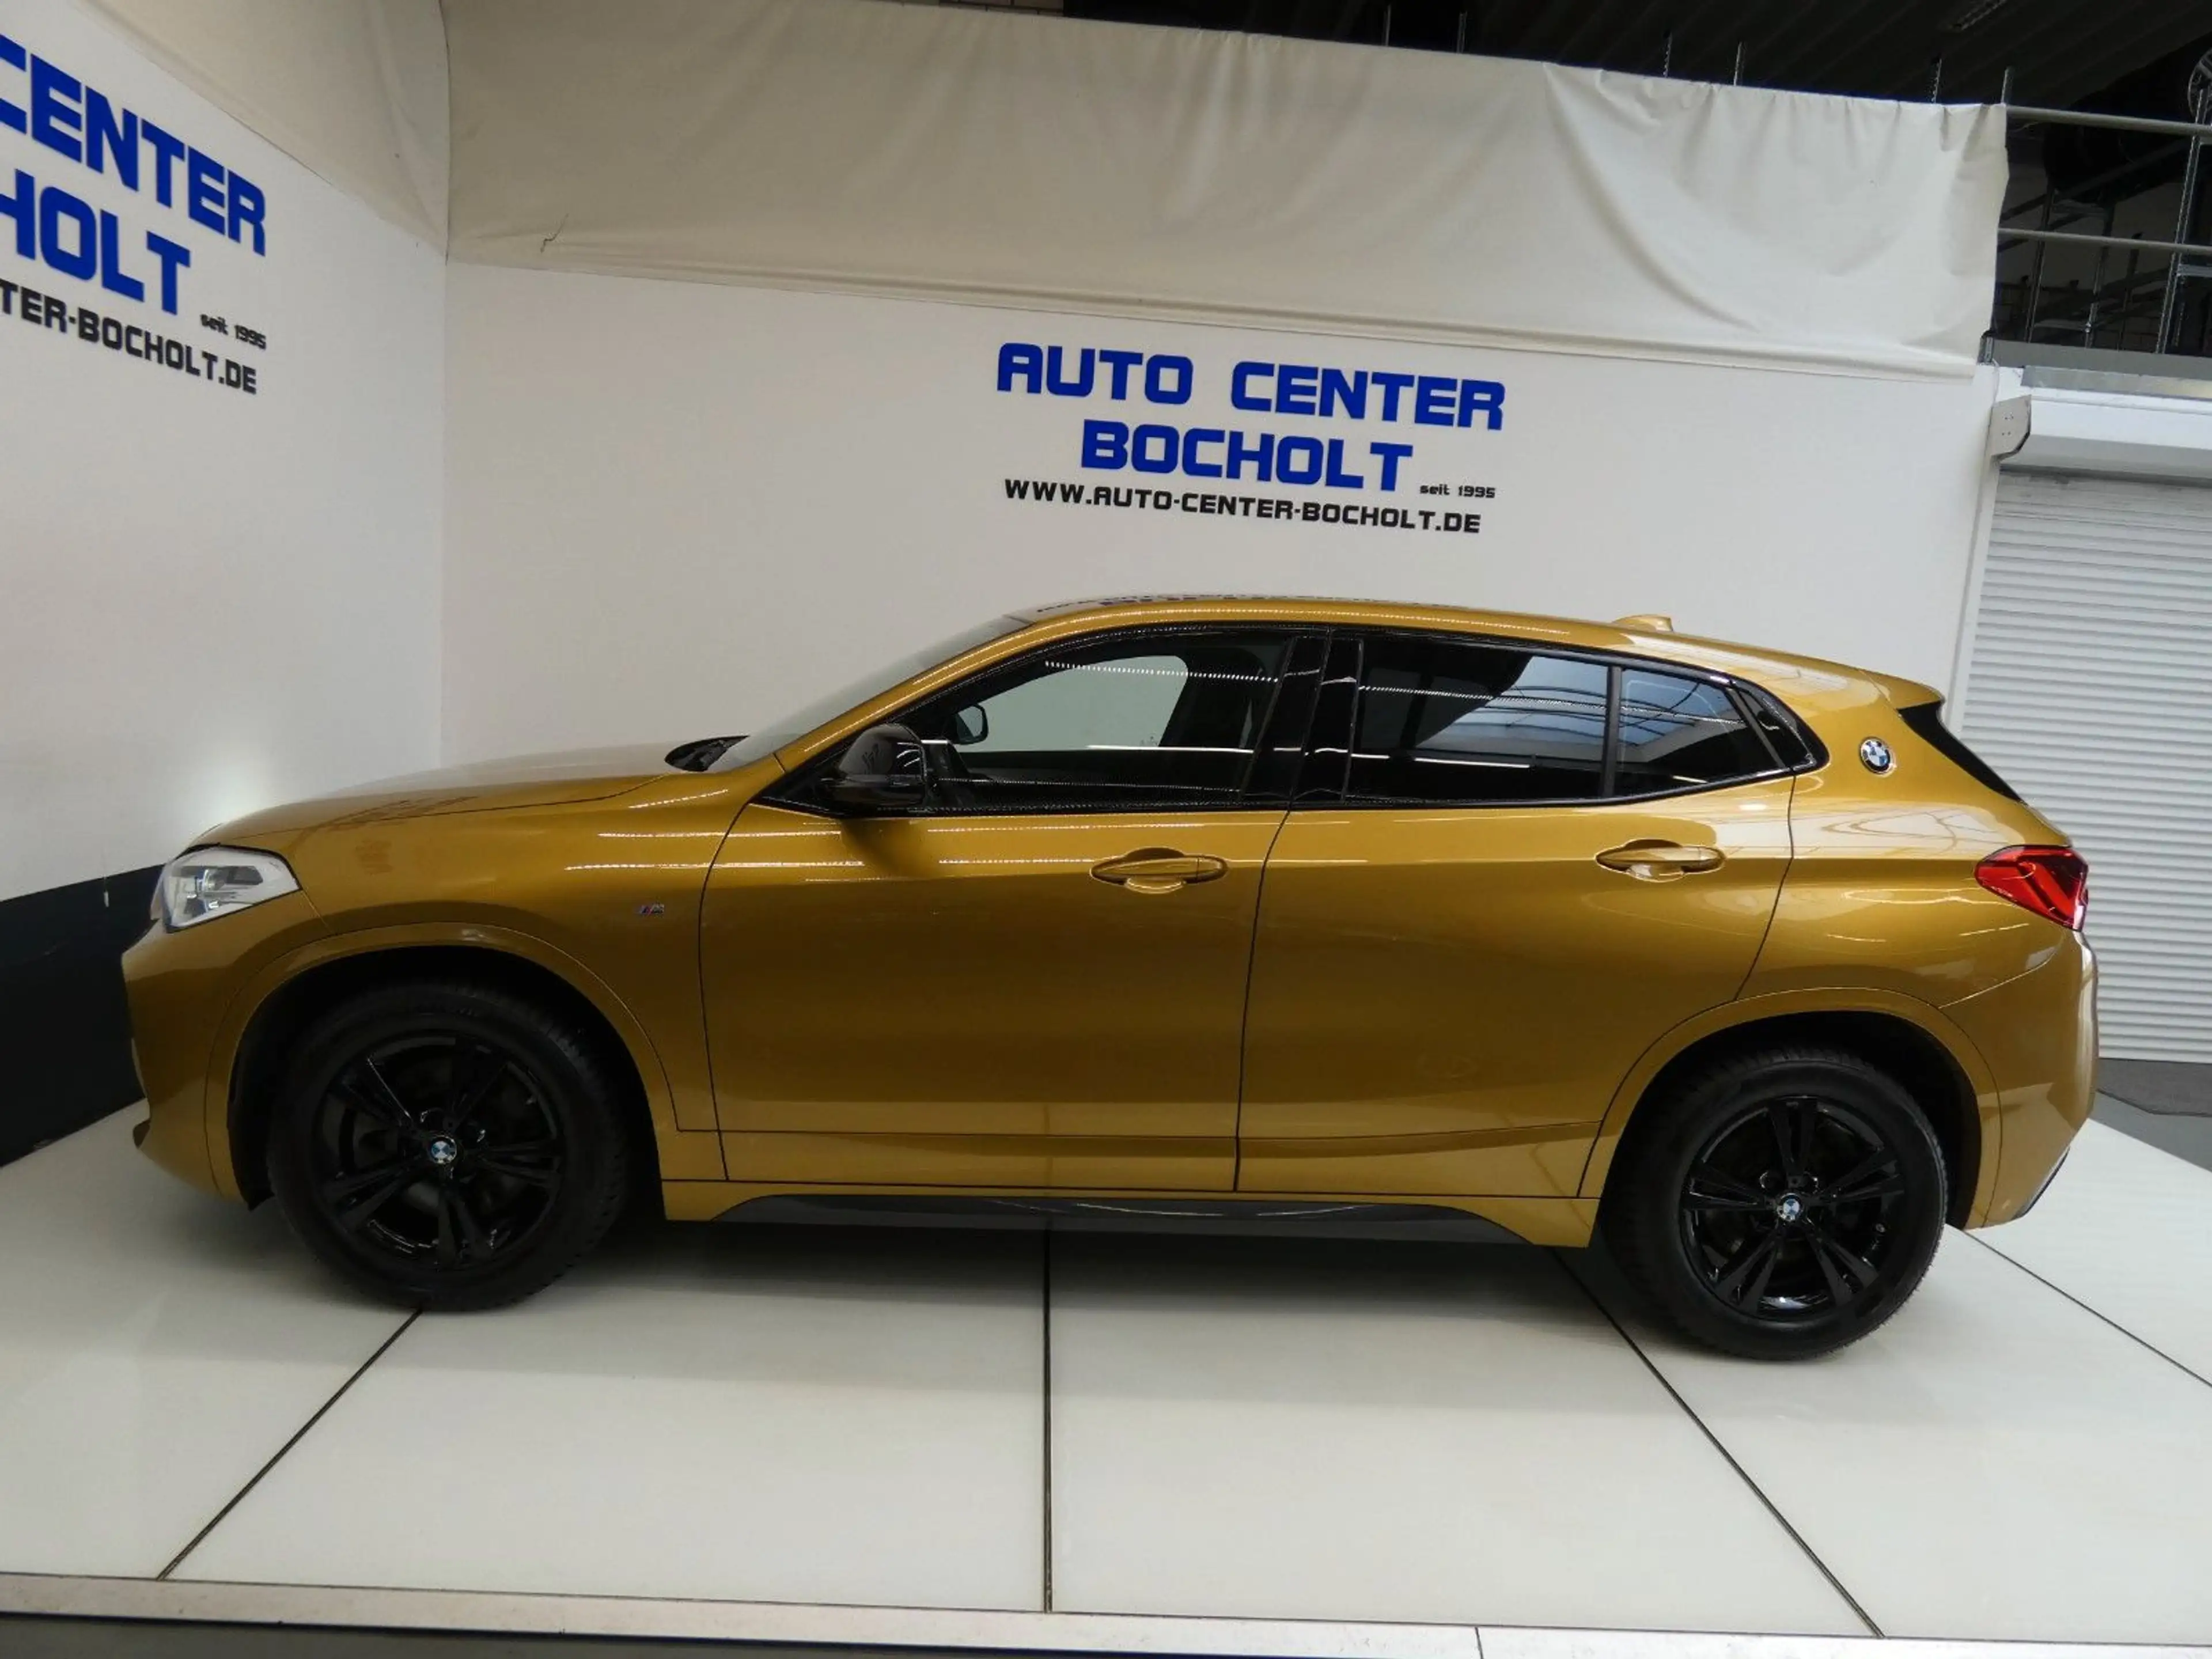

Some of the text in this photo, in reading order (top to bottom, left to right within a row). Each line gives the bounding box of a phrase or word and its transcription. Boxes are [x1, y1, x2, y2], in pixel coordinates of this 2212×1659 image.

[234, 325, 266, 350] 1995
[997, 343, 1506, 430] AUTO CENTER
[1081, 419, 1414, 492] BOCHOLT
[1004, 479, 1481, 533] WWW.AUTO-CENTER-BOCHOLT.DE
[1419, 483, 1495, 498] seit 1995
